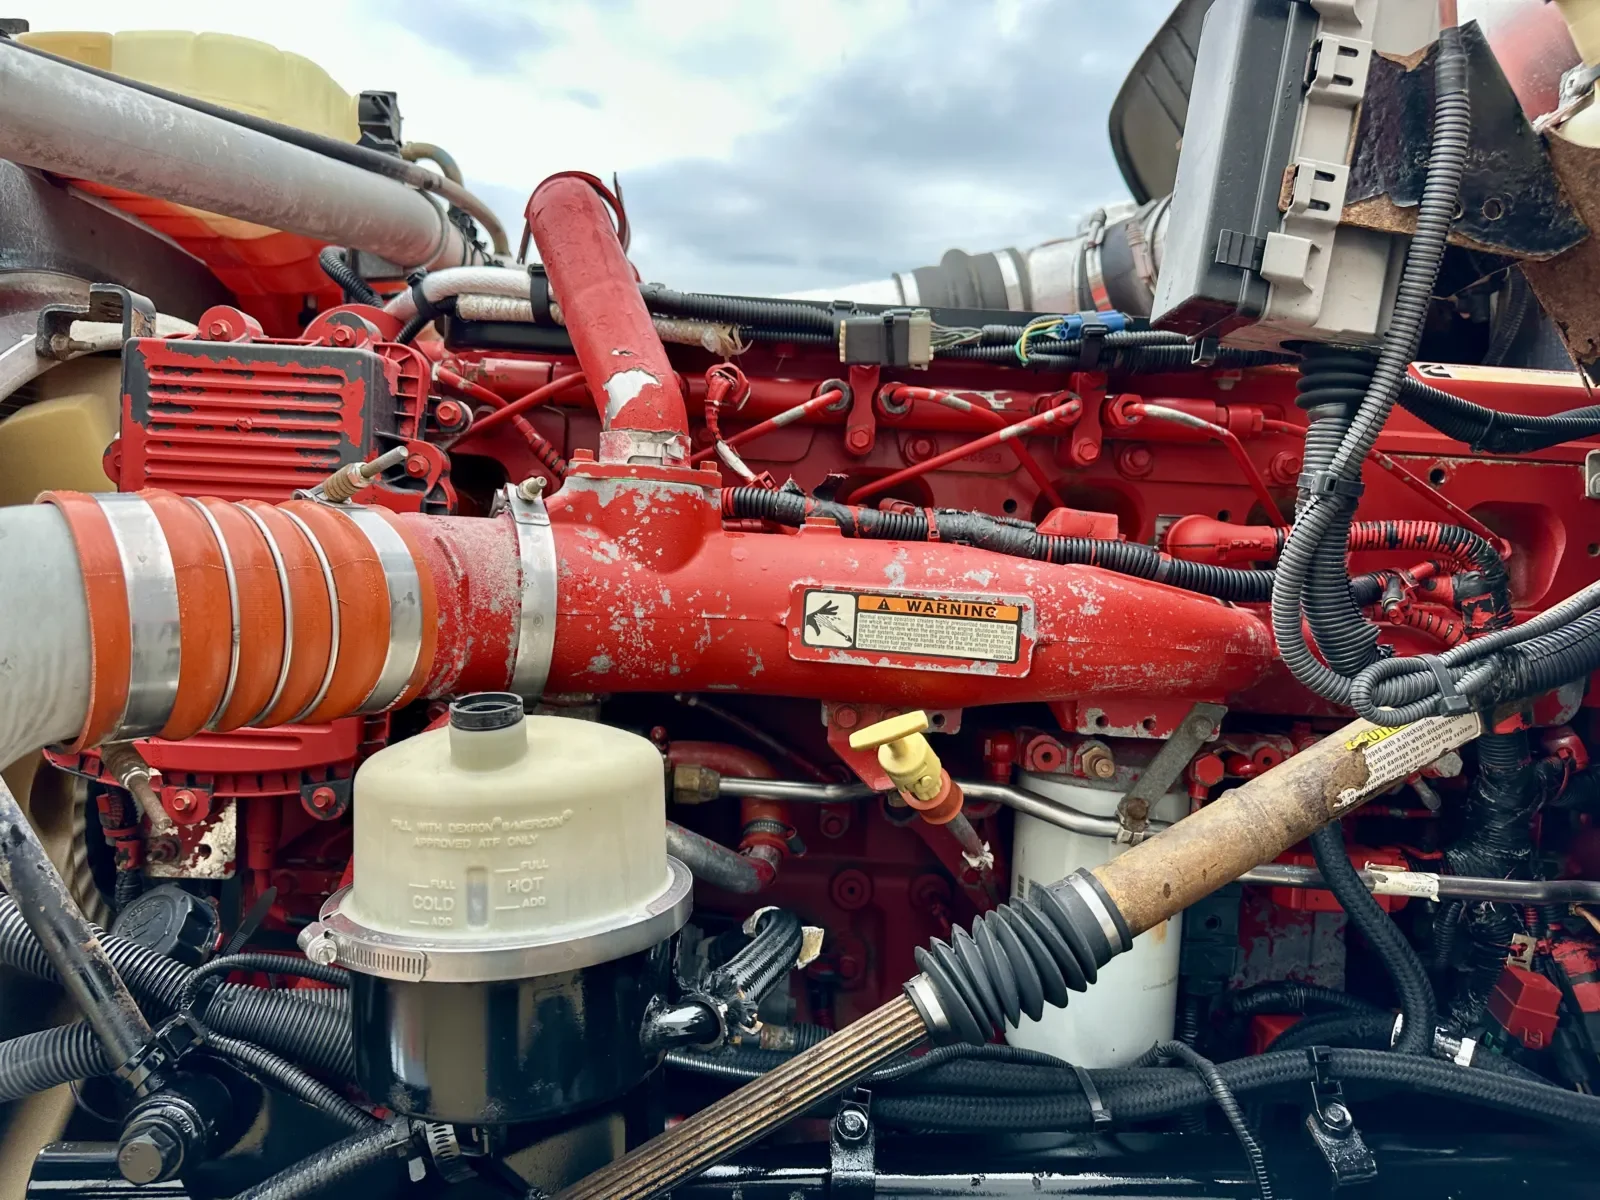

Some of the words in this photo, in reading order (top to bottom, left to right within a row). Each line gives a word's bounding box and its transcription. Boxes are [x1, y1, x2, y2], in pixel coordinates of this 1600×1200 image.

[907, 600, 997, 618] WARNING
[1383, 739, 1395, 749] with
[1401, 718, 1434, 739] clockspring
[1432, 740, 1440, 749] air
[1442, 734, 1452, 744] bag
[1373, 748, 1394, 764] column
[1410, 731, 1425, 744] when
[1374, 763, 1385, 773] may
[1386, 749, 1409, 766] damage
[1409, 744, 1419, 754] the
[1420, 725, 1452, 747] clockspring
[417, 821, 442, 833] WITH
[413, 836, 471, 849] APPROVED
[478, 837, 500, 849] ATF
[507, 833, 539, 847] ONLY
[520, 859, 549, 870] FULL
[430, 879, 456, 890] FULL
[507, 876, 544, 893] HOT
[412, 895, 454, 911] COLD
[522, 896, 546, 908] ADD
[431, 917, 453, 926] ADD
